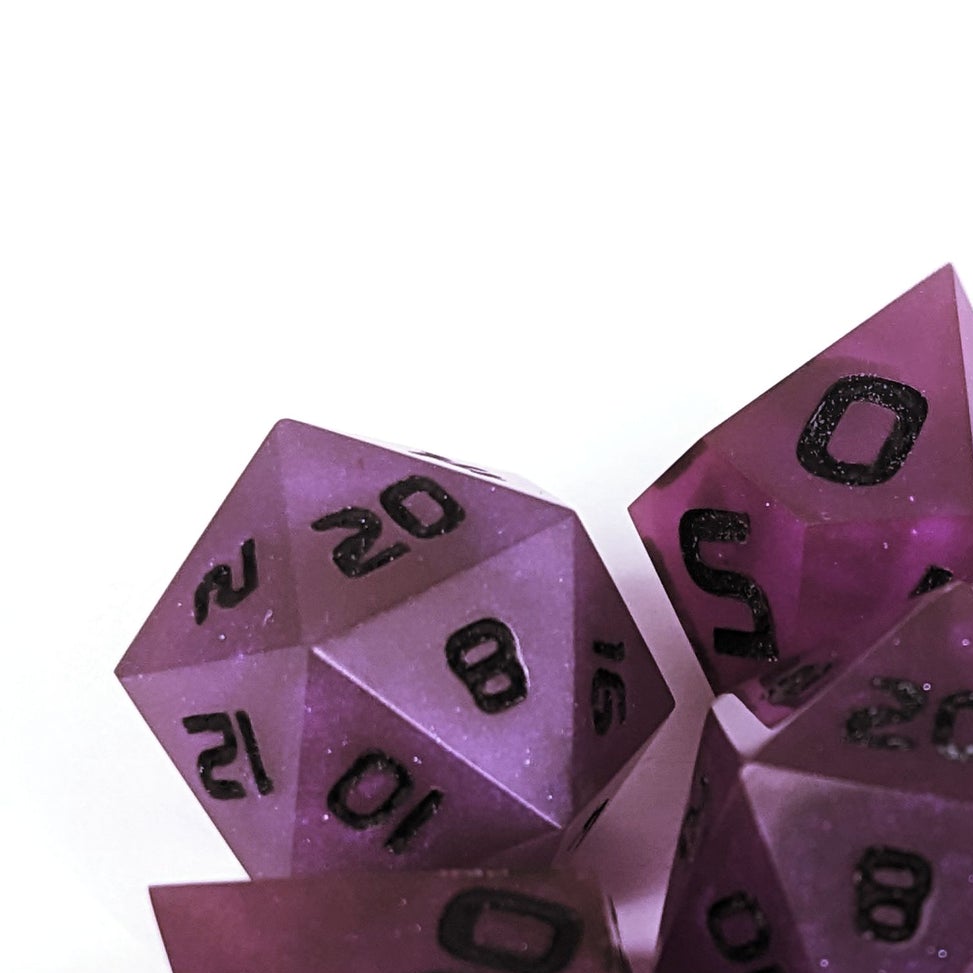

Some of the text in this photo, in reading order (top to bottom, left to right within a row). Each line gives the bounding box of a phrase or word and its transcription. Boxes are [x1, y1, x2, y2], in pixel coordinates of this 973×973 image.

[796, 373, 929, 487] 0
[311, 474, 466, 578] 20
[194, 538, 259, 625] 2
[678, 508, 779, 661] 5
[445, 617, 530, 714] 8
[182, 710, 273, 800] 12
[327, 748, 444, 855] 10
[853, 844, 934, 944] 8
